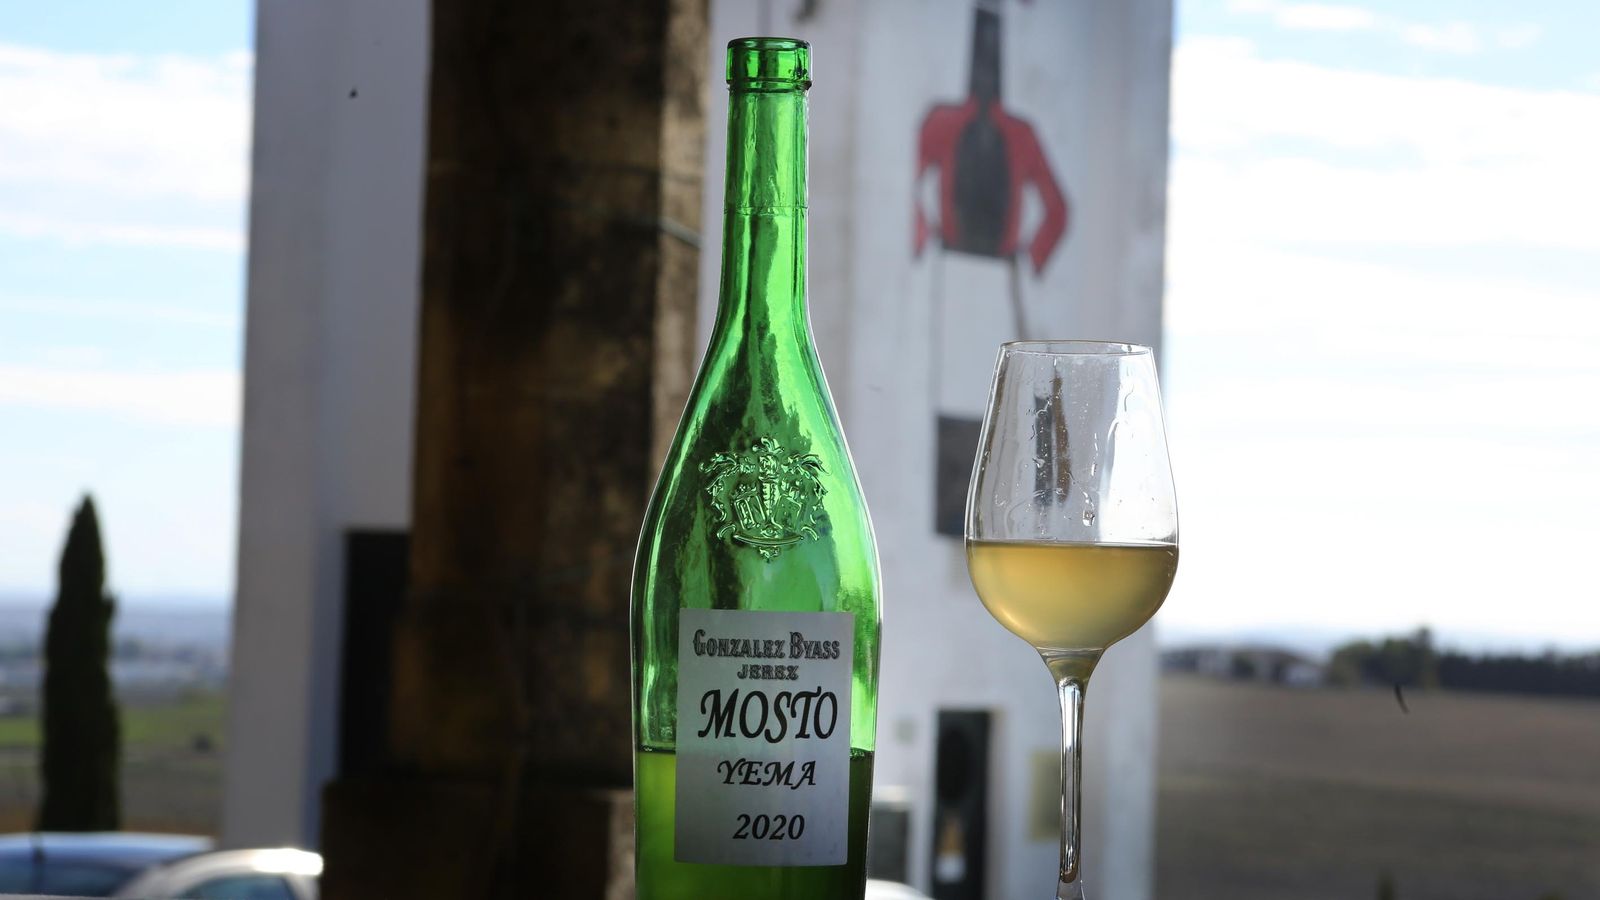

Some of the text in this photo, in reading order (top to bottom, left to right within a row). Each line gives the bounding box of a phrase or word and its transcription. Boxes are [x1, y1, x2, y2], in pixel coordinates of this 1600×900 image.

[693, 629, 840, 660] GONZALEZ BYASS
[737, 664, 799, 681] JEREZ
[697, 686, 838, 743] MOSTO
[717, 757, 816, 790] YEMA
[732, 814, 805, 841] 2020
